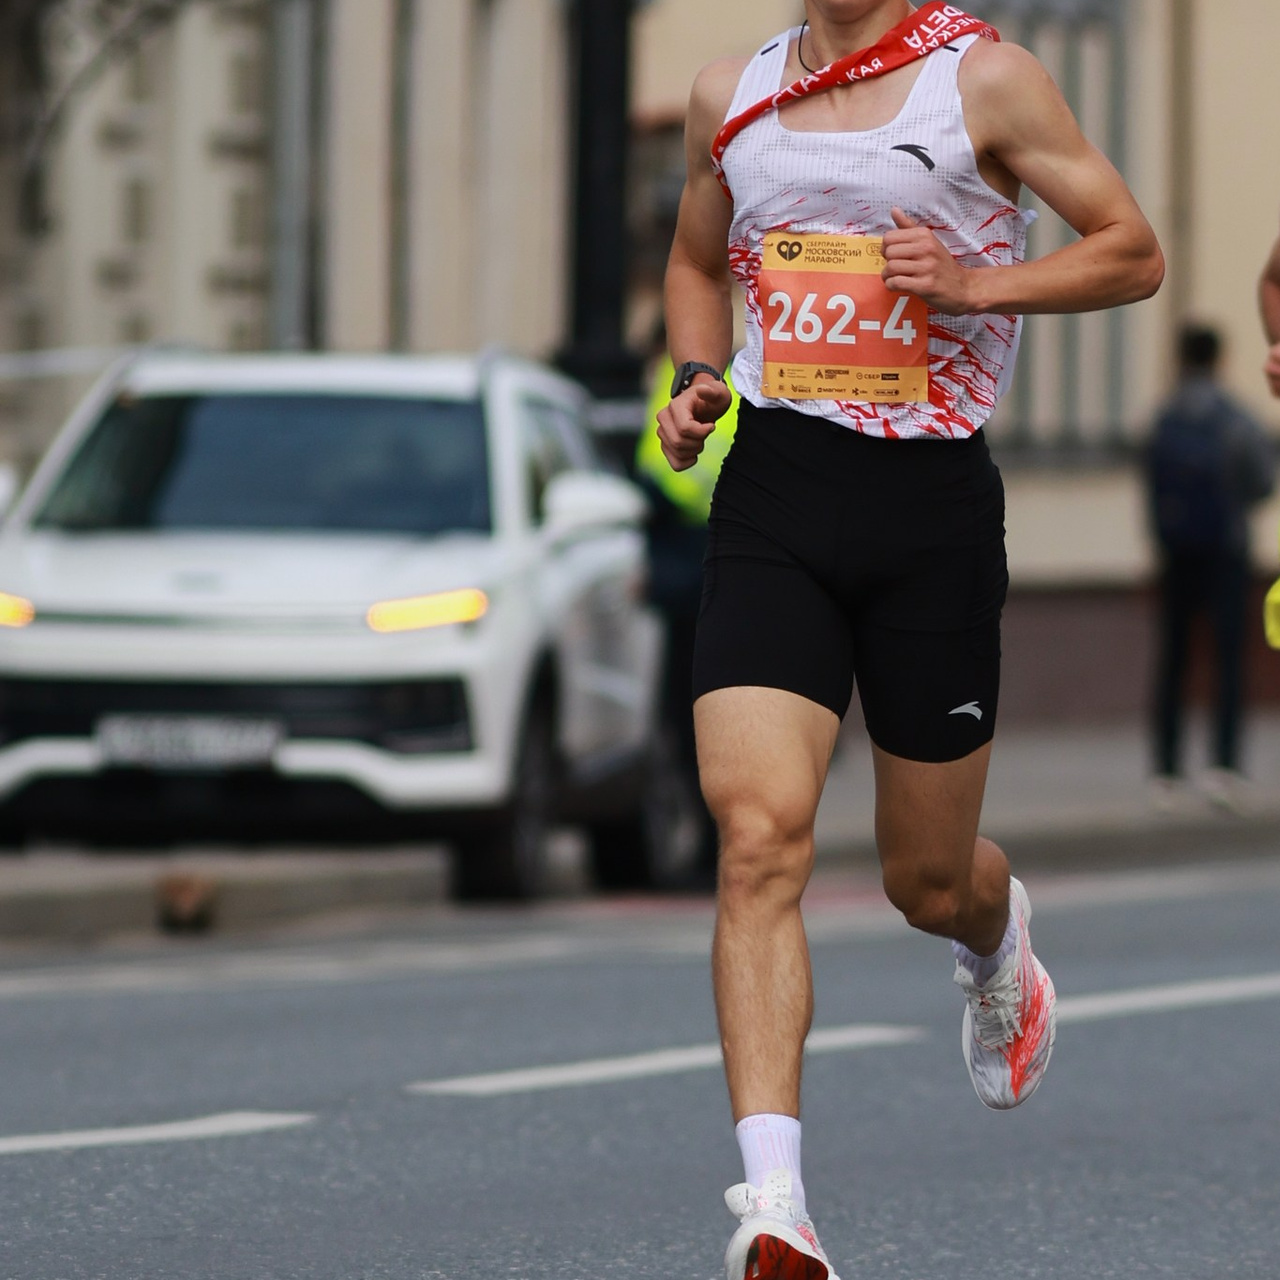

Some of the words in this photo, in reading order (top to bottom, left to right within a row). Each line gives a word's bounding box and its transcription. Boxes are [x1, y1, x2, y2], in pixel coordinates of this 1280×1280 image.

[806, 240, 847, 248] СБЕРПРАЙМ
[805, 248, 862, 257] МОСКОВСКИЙ
[804, 256, 846, 264] МАРАФОН
[768, 291, 917, 346] 262-4
